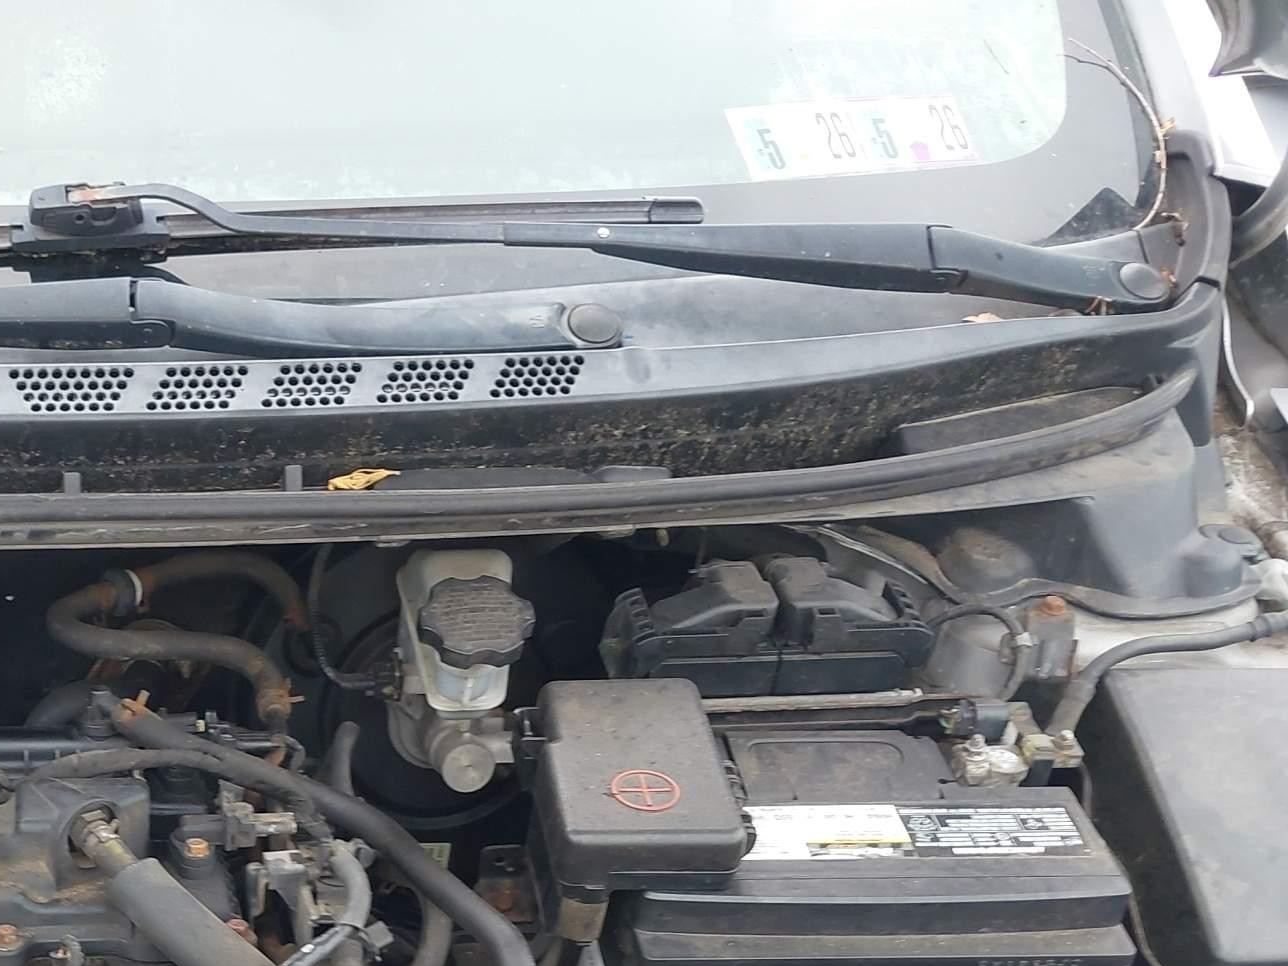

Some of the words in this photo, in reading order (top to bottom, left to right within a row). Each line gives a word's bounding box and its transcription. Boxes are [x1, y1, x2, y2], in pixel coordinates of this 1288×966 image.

[756, 127, 787, 170] 5
[814, 112, 857, 159] 26
[870, 117, 899, 159] 5
[928, 104, 969, 150] 26
